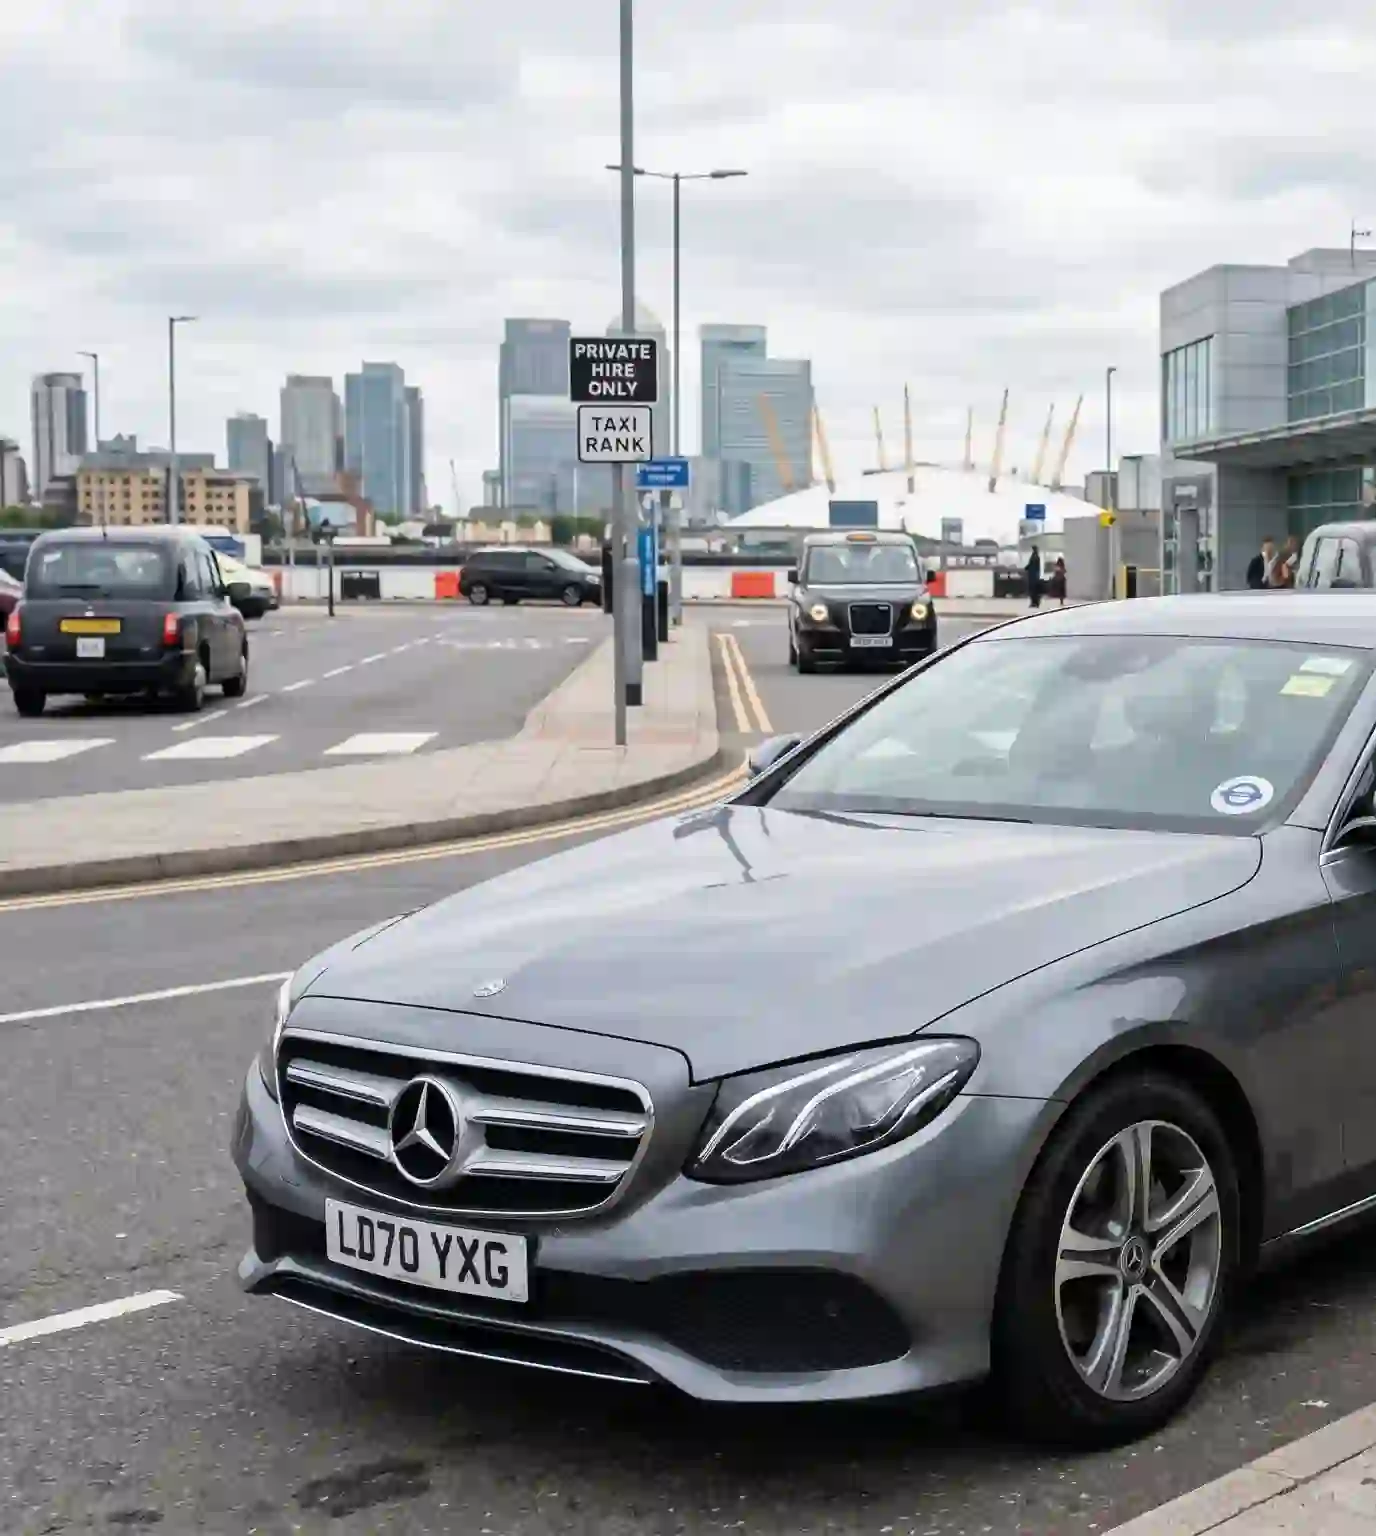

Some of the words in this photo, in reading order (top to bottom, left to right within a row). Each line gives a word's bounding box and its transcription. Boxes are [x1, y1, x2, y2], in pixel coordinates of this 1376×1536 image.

[574, 342, 651, 360] PRIVATE
[591, 362, 636, 378] HIRE
[588, 380, 638, 397] ONLY
[591, 416, 637, 433] TAXI
[586, 436, 645, 453] RANK
[338, 1209, 419, 1273] LD70
[430, 1231, 509, 1289] YXG
